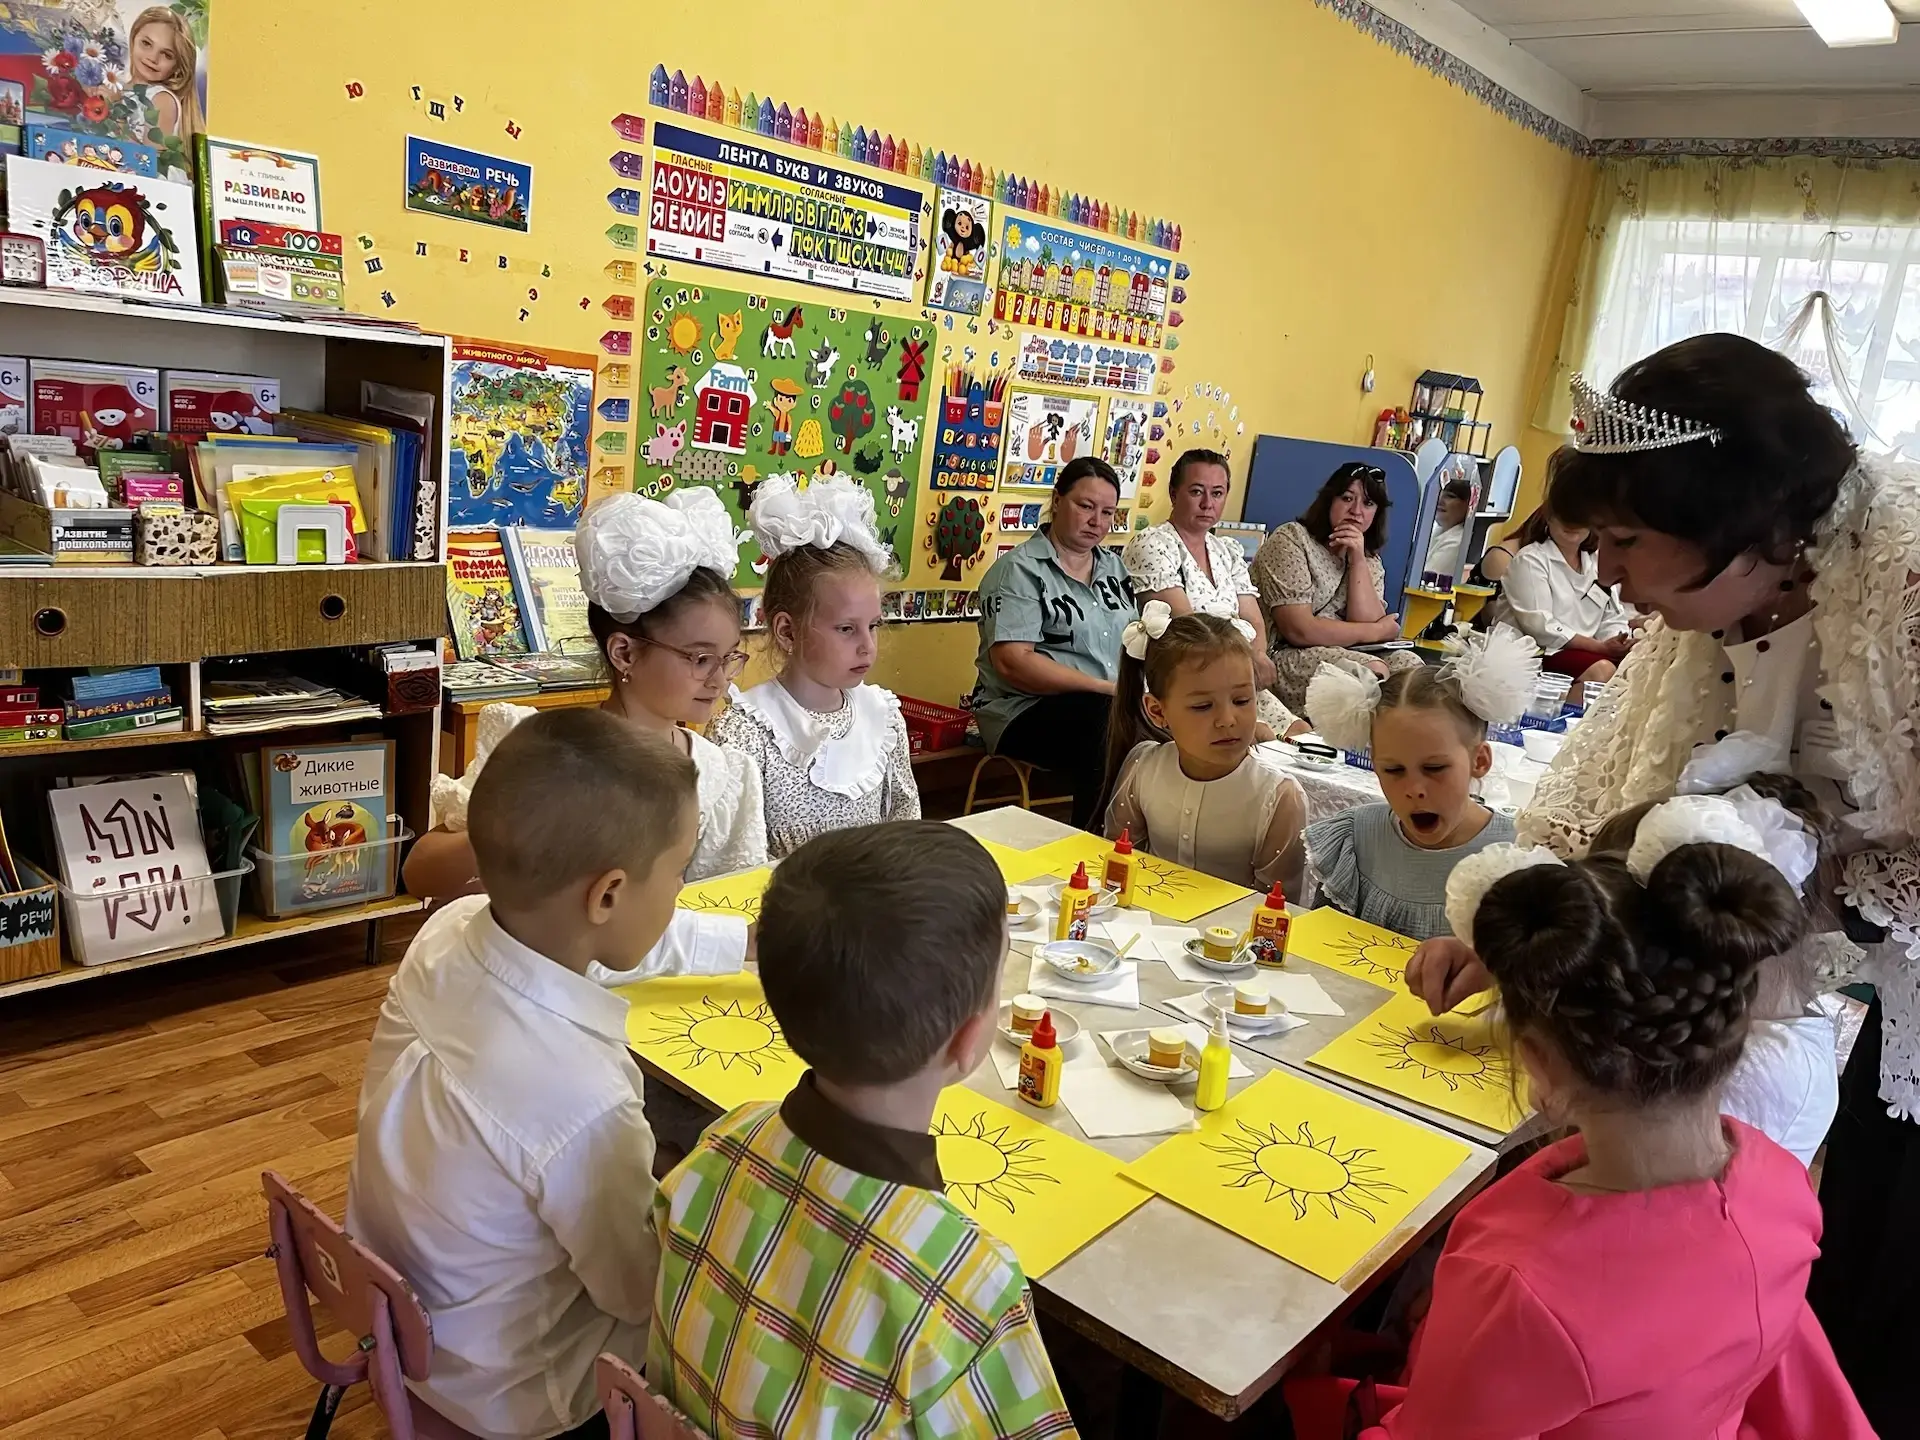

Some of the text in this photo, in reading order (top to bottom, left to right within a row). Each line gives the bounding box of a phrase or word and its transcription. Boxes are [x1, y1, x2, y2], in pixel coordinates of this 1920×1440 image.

[346, 82, 363, 98] Ю
[420, 152, 519, 187] Развиваем РЕЧЬ
[671, 154, 713, 172] ГЛАСНЫЕ
[718, 143, 884, 199] ЛЕНТА БУКВ И ЗВУКОВ
[224, 180, 305, 204] РАЗВИВАЮ
[800, 187, 846, 205] СОГЛАСНЫЕ
[224, 196, 276, 210] МЫШЛЕНИЕ
[285, 205, 307, 214] РЕЧЬ
[236, 229, 251, 243] IQ
[283, 232, 321, 252] 100
[459, 249, 468, 263] Е
[1041, 231, 1074, 248] СОСТАВ
[1079, 240, 1106, 255] ЧИСЕЛ
[1122, 255, 1131, 263] до
[1134, 256, 1142, 264] 10
[260, 262, 337, 279] АРТИКУЛЯЦИОННАЯ
[498, 256, 507, 268] В
[794, 260, 817, 270] ПАРНЫЕ
[820, 264, 855, 276] СОГЛАСНЫЕ
[999, 294, 1005, 313] 0
[1015, 299, 1022, 316] 2
[1031, 302, 1037, 318] 4
[1047, 304, 1053, 321] 6
[1063, 308, 1069, 325] 8
[1080, 312, 1089, 328] 10
[462, 349, 541, 366] ЖИВОТНОГО МИРА
[1, 371, 20, 385] 6+
[709, 368, 748, 393] Farm
[136, 382, 155, 395] 6+
[261, 389, 276, 402] 6+
[945, 432, 952, 442] 2
[940, 474, 946, 484] 5
[969, 474, 975, 484] 3
[58, 540, 133, 550] ДОШКОЛЬНИКА
[453, 560, 507, 571] ПРАВИЛ
[455, 570, 509, 579] ПОВЕДЕНИ
[305, 760, 355, 777] Дикие
[300, 779, 380, 796] животные
[20, 908, 52, 928] РЕЧИ
